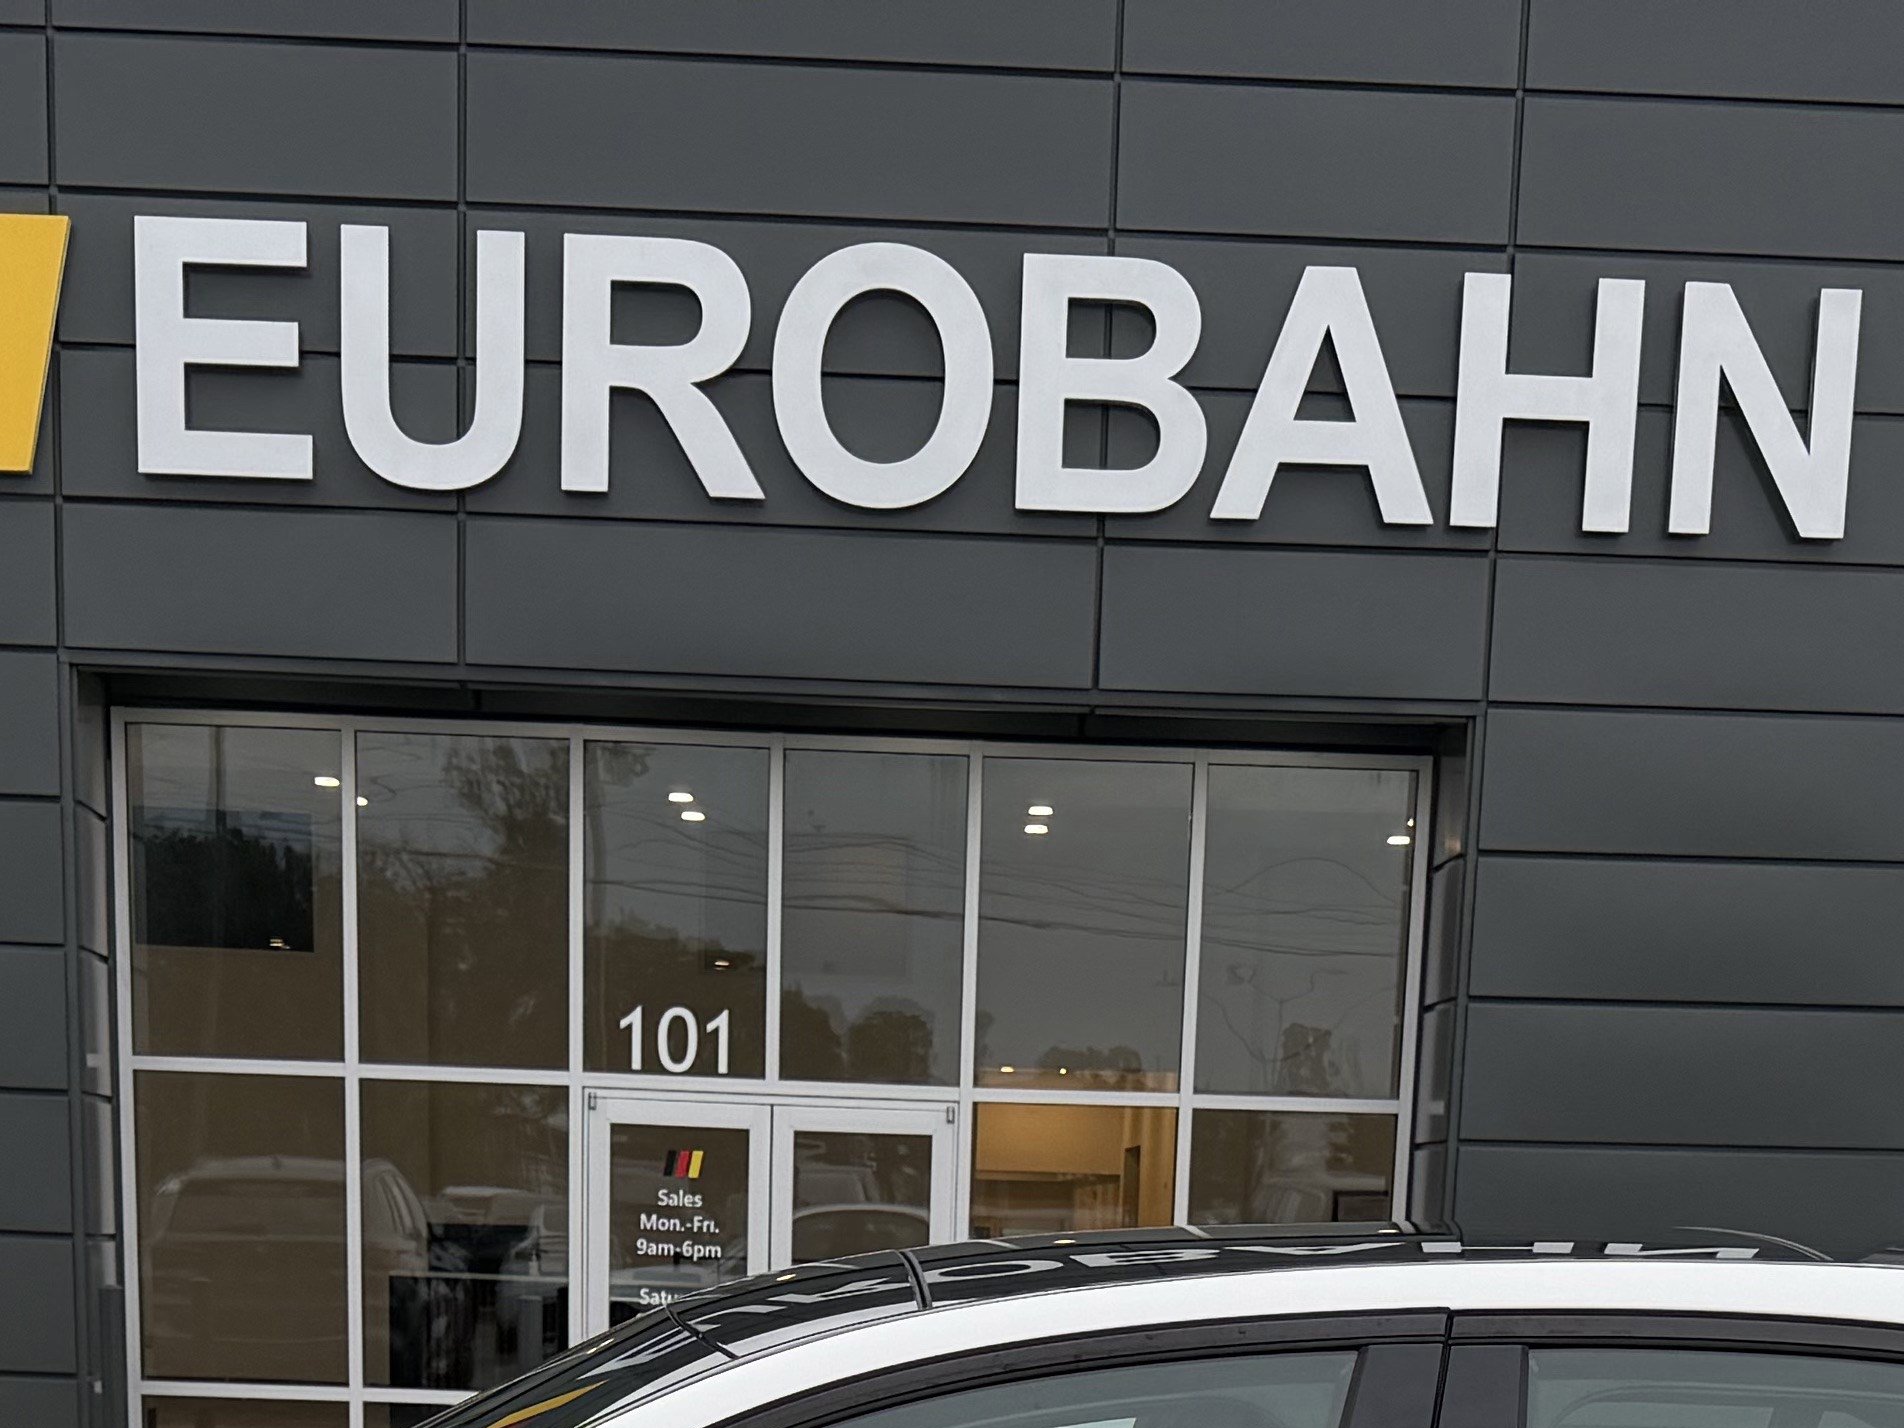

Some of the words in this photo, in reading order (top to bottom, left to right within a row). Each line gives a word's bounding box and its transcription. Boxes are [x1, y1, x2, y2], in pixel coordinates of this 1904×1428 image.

[133, 214, 1863, 541] EUROBAHN
[618, 1005, 730, 1075] 101
[657, 1188, 703, 1208] Sales
[639, 1213, 720, 1234] Mon.-Fri.
[636, 1238, 722, 1261] 9am-6pm
[639, 1288, 679, 1305] Satu
